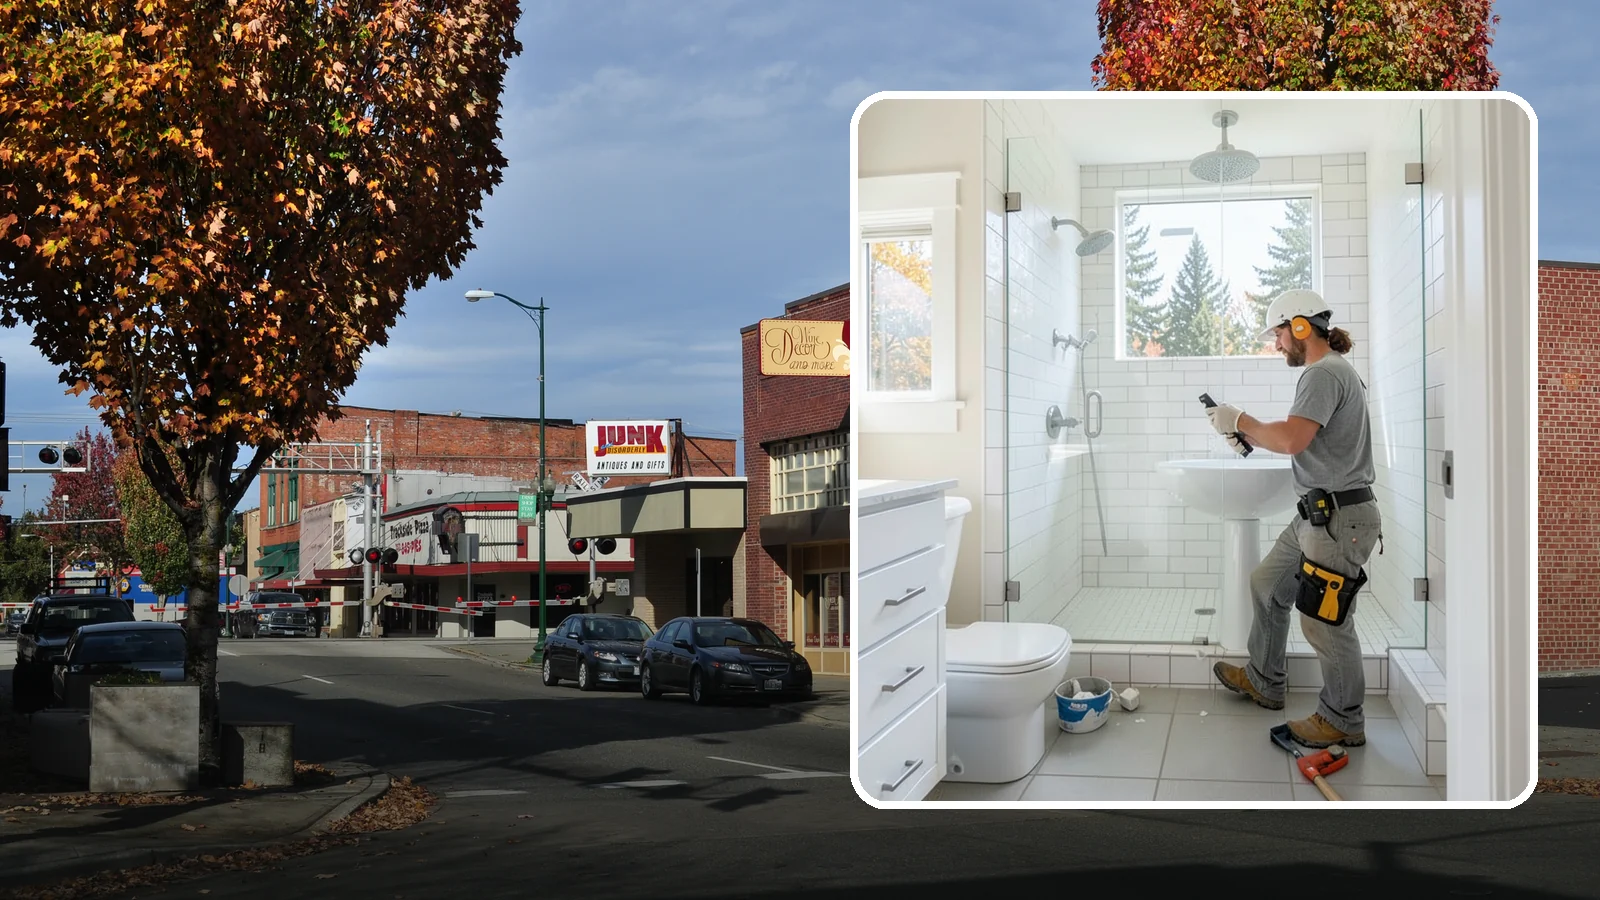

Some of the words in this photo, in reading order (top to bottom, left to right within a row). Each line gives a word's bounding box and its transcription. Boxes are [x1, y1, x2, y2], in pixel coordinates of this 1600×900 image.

[595, 425, 665, 457] JUNK
[607, 446, 646, 454] DISORDERLY
[597, 461, 628, 470] ANTIQUES
[631, 461, 644, 470] AND
[646, 460, 665, 470] GIFTS
[390, 521, 413, 540] Trackside
[414, 519, 429, 535] Pizza
